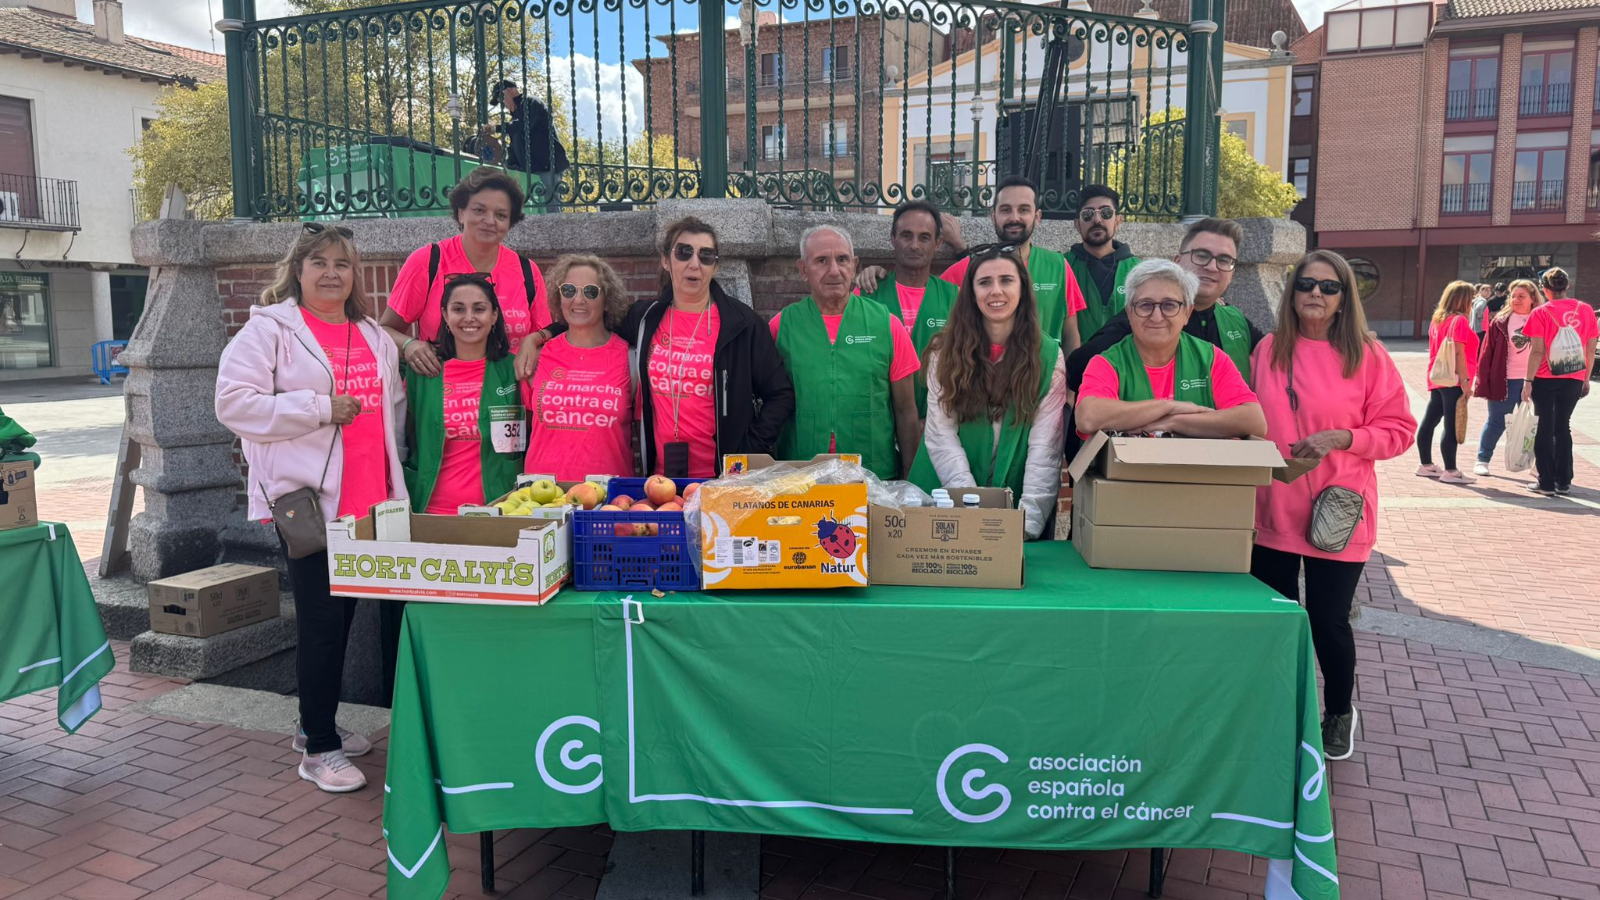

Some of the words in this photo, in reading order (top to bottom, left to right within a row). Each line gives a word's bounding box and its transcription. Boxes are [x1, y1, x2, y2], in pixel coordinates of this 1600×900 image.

[503, 307, 526, 318] cha
[654, 344, 669, 357] En
[672, 350, 713, 363] march
[344, 362, 378, 374] marc
[649, 360, 697, 379] contra
[337, 375, 382, 390] ontra
[546, 381, 563, 391] En
[567, 384, 622, 396] marcha
[541, 394, 599, 408] contra
[602, 397, 619, 412] el
[443, 409, 480, 423] cont
[543, 407, 617, 428] cáncer
[732, 501, 776, 509] PLATANOS
[778, 501, 789, 509] DE
[791, 500, 835, 508] CANARIAS
[888, 530, 903, 538] x20
[334, 554, 416, 580] HORT
[420, 556, 535, 586] CALVÍS
[821, 562, 856, 573] Natur
[1029, 753, 1142, 773] asociación
[1028, 778, 1125, 799] española
[1027, 803, 1095, 819] contra
[1101, 803, 1119, 819] el
[1123, 802, 1194, 821] cáncer
